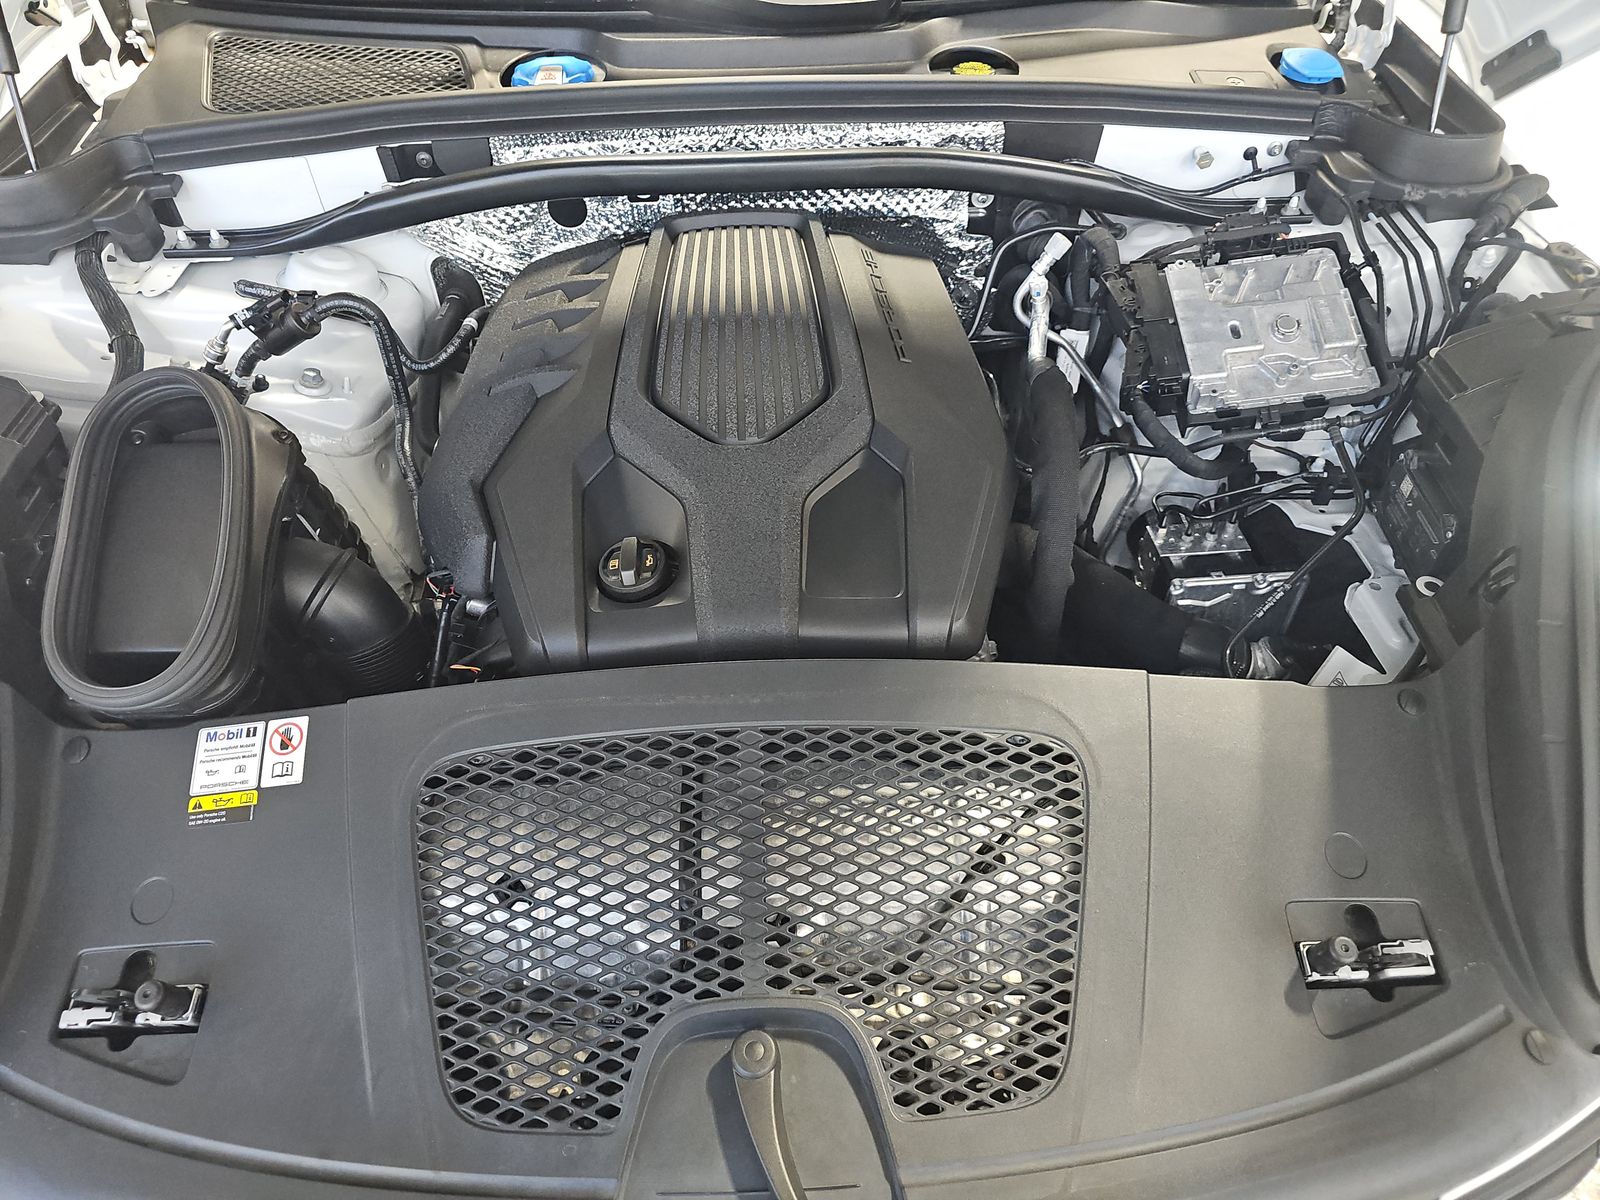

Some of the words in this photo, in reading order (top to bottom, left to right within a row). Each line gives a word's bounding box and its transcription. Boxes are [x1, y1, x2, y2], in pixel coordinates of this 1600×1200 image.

[205, 728, 244, 743] Mobil
[245, 726, 258, 738] 1
[200, 780, 250, 790] PORSCHE
